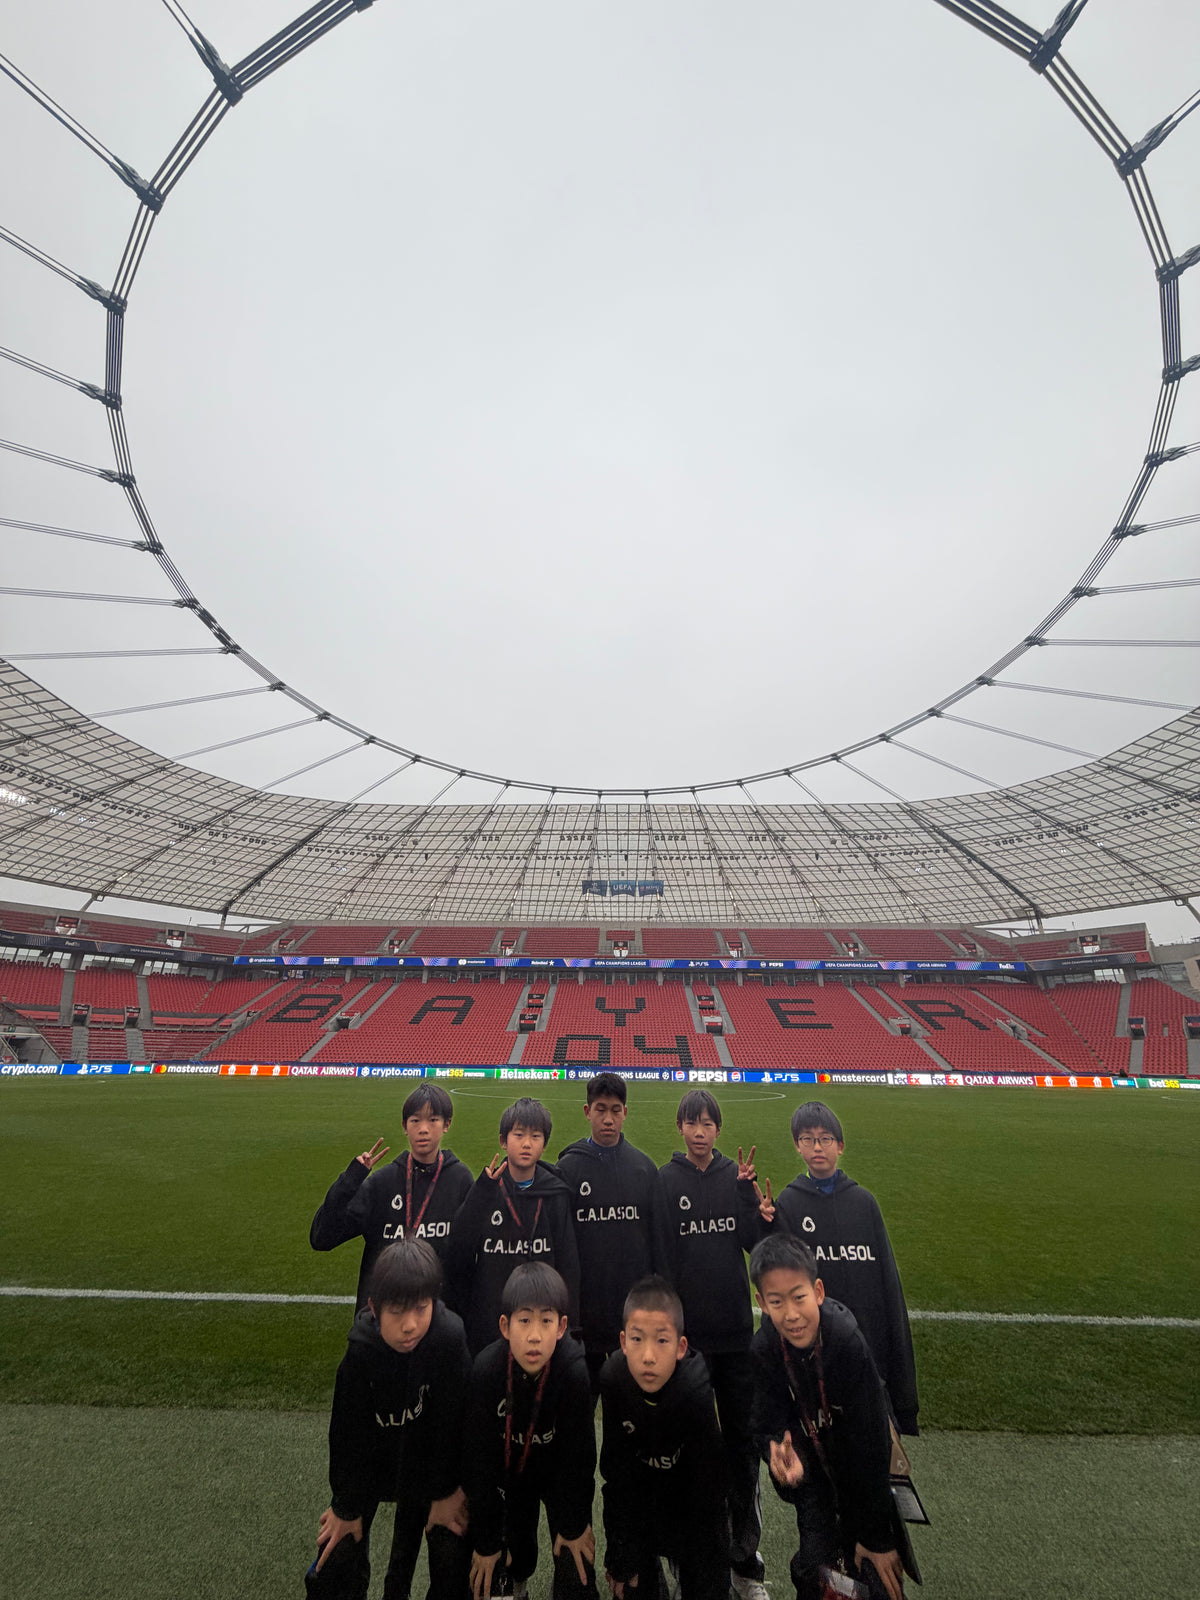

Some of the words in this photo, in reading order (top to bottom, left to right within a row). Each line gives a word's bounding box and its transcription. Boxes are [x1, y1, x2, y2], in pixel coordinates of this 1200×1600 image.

[0, 1064, 58, 1076] crypto.com
[89, 1065, 113, 1073] PS5
[167, 1064, 219, 1074] mastercard
[290, 1066, 318, 1076] QATAR
[320, 1066, 355, 1076] AIRWAYS
[371, 1067, 421, 1078] crypto.com
[435, 1068, 464, 1077] bet365
[500, 1068, 550, 1079] Heineken
[578, 1071, 596, 1079] UEFA
[635, 1072, 660, 1080] LEAGUE
[688, 1070, 728, 1082] PEPSI
[774, 1073, 800, 1082] PS5
[832, 1073, 887, 1082] mastercard
[964, 1076, 995, 1085] QATAR
[997, 1076, 1034, 1085] AIRWAYS
[1148, 1079, 1180, 1089] bet365
[577, 1206, 640, 1222] C.A.LASOL
